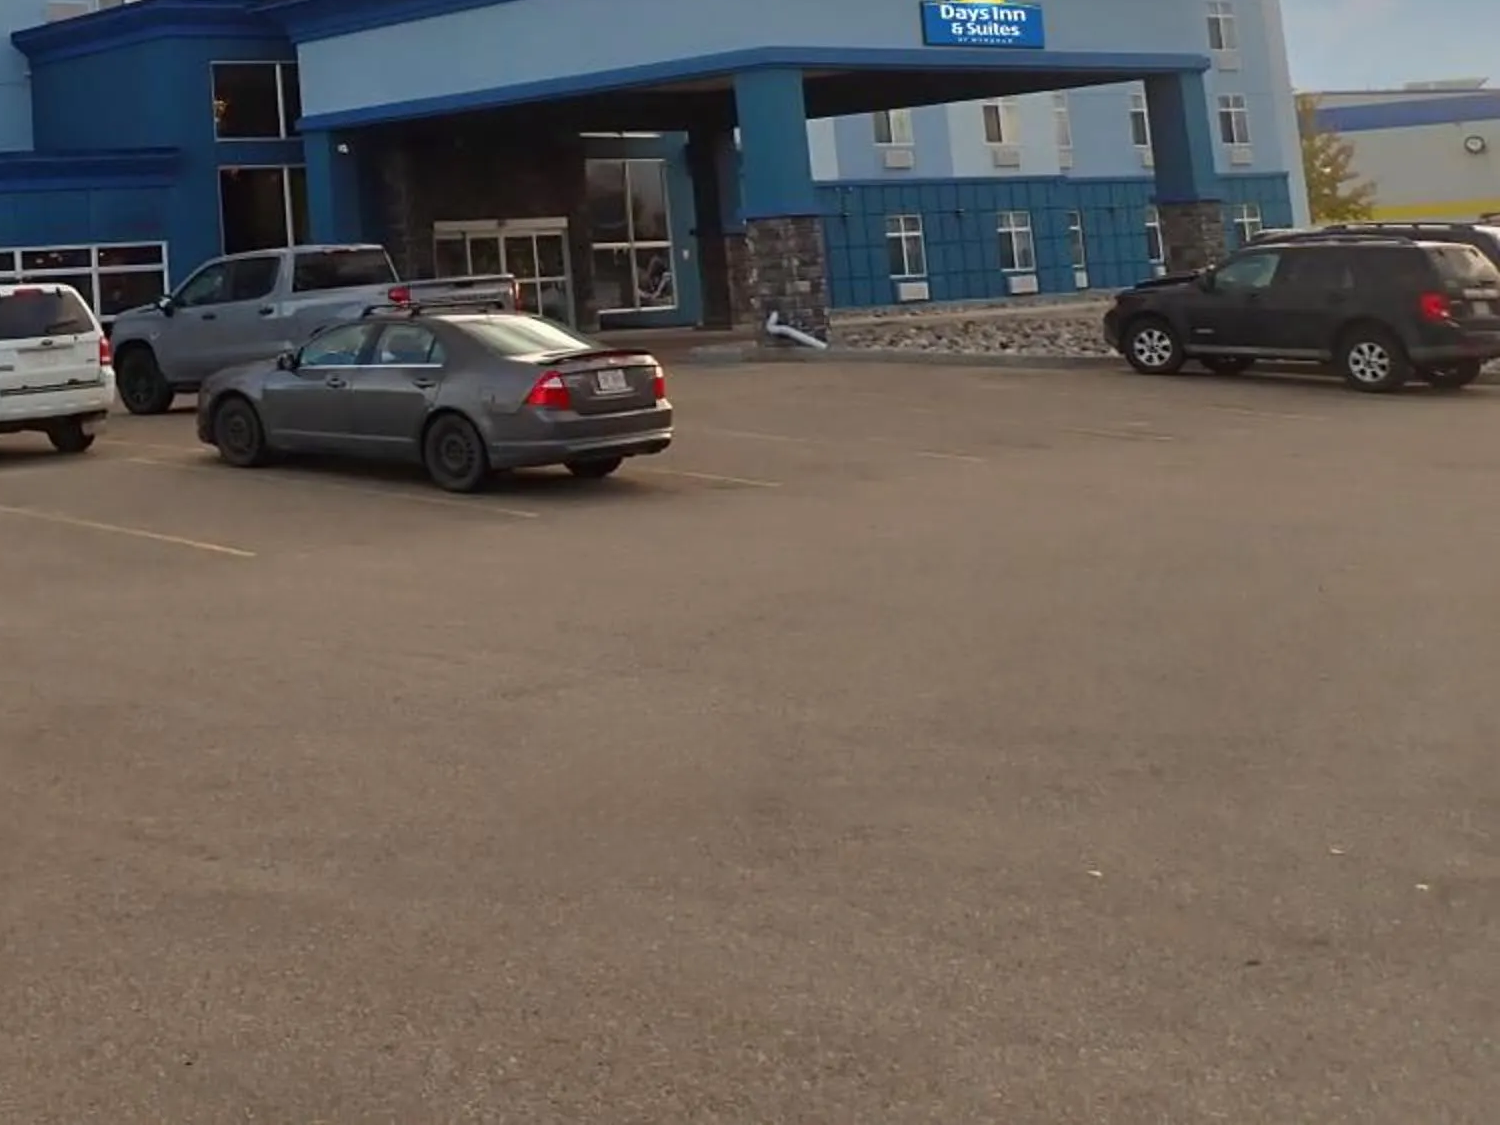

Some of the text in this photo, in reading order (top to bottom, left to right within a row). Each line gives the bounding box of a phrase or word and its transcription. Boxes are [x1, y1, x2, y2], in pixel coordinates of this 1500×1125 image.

[940, 4, 1027, 22] Days Inn
[951, 21, 1021, 36] & Suites
